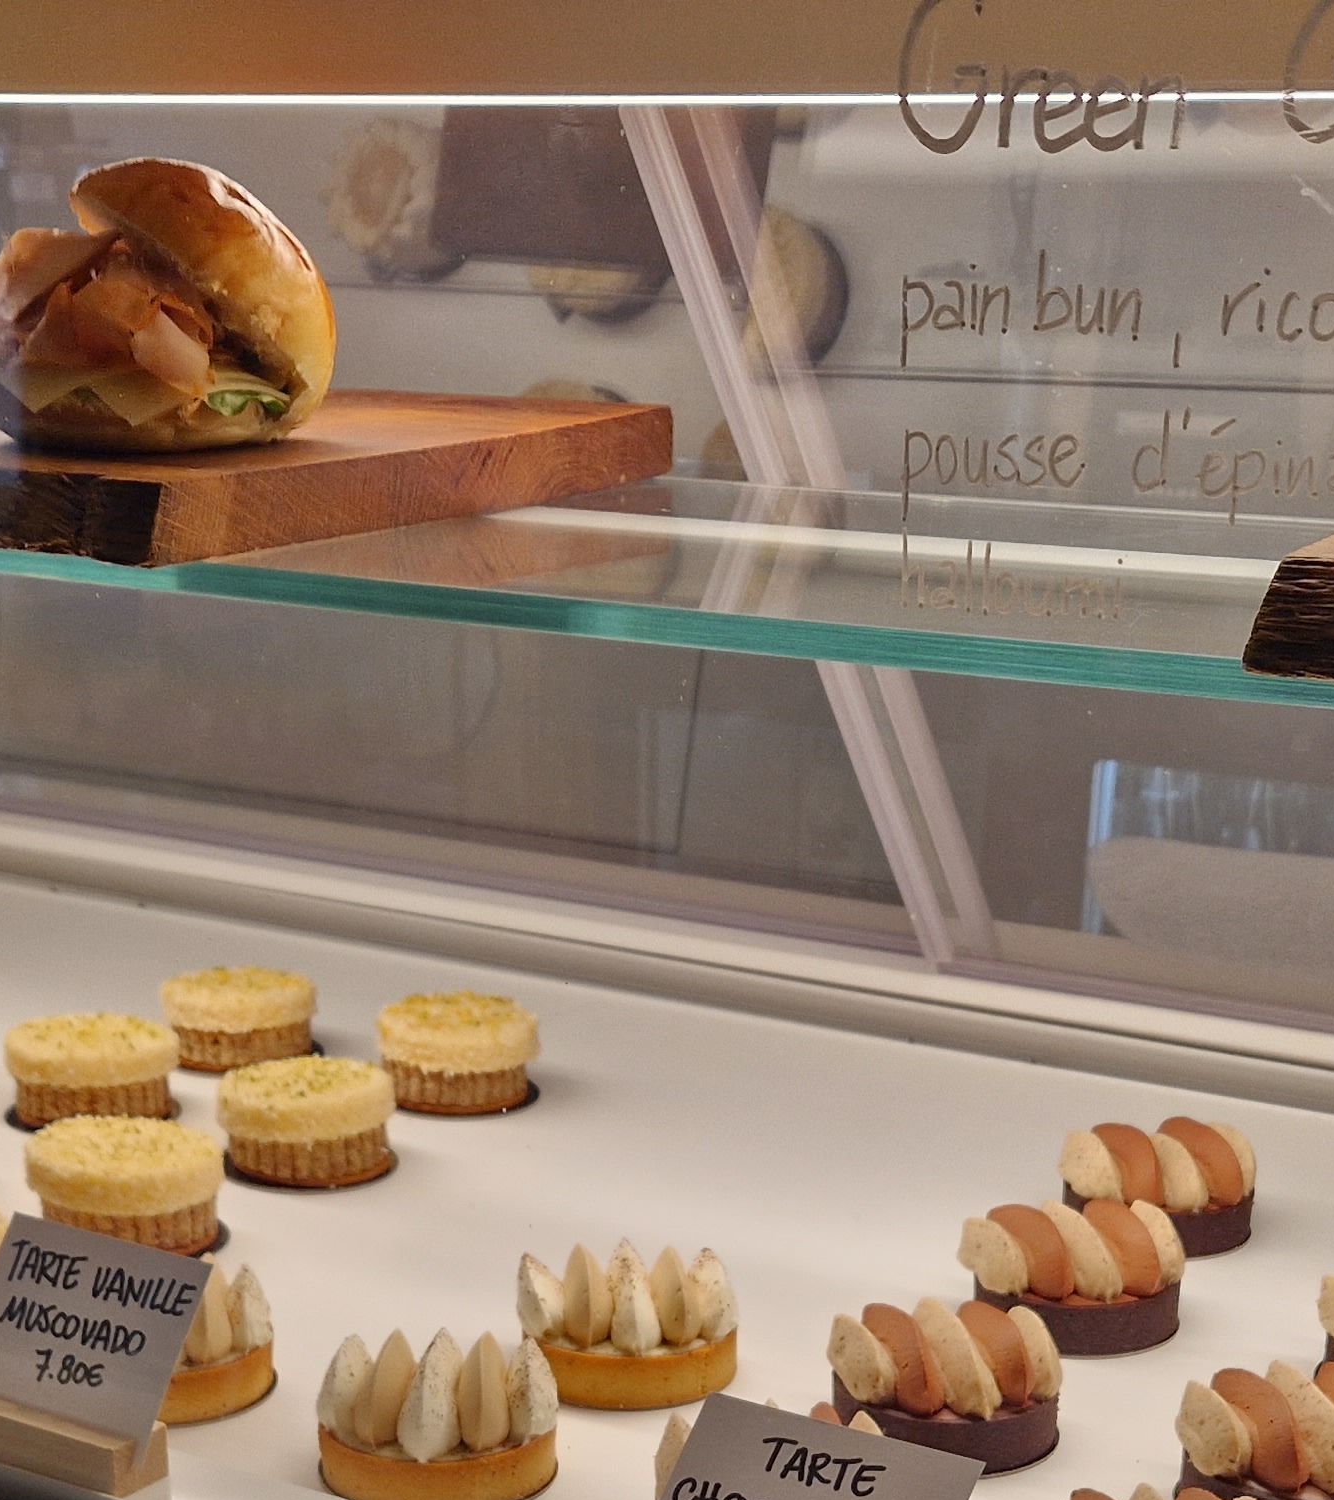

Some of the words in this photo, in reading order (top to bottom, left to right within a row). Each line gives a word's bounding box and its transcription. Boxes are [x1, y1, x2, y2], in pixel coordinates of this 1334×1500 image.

[898, 0, 1189, 154] Green
[899, 262, 1010, 368] pain
[900, 427, 1087, 522] pousse
[7, 1239, 88, 1290] TARTE
[91, 1266, 198, 1317] VANILLE
[35, 1348, 106, 1387] 7.80€
[762, 1436, 887, 1497] TARTE
